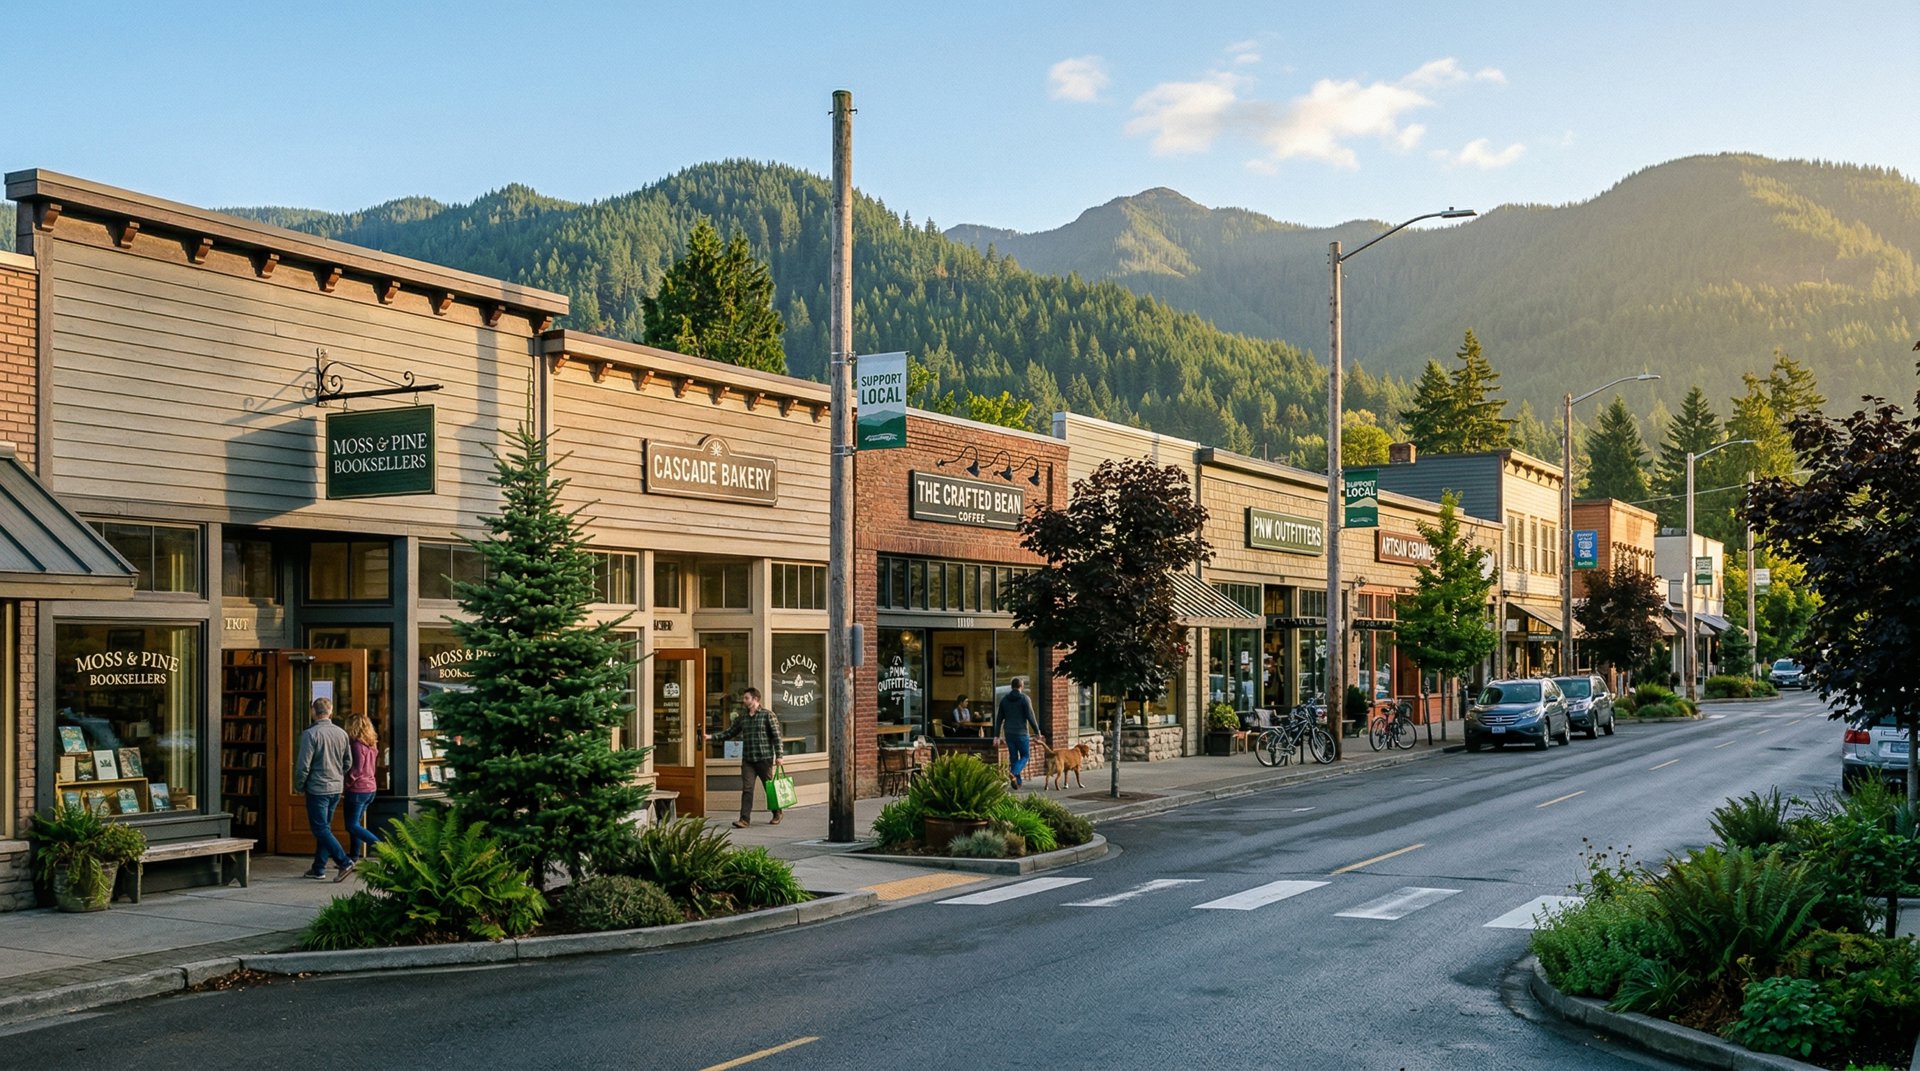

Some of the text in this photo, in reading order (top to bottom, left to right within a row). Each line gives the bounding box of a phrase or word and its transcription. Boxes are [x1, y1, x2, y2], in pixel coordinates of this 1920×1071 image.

[861, 373, 902, 387] SUPPORT
[862, 387, 902, 405] LOCAL
[333, 433, 427, 455] MOSS & PINE
[334, 454, 426, 474] BOOKSELLERS
[654, 454, 771, 491] CASCADE BAKERY
[918, 480, 1021, 514] THE CRAFTED BEAN
[1346, 487, 1376, 497] LOCAL
[958, 511, 985, 523] COFFEE
[1253, 516, 1322, 547] PNW OUTFITTERS
[1381, 536, 1407, 557] ARTISAN
[75, 651, 180, 673] MOSS & PINE
[429, 649, 463, 669] MOSS
[465, 649, 474, 660] &
[780, 654, 818, 675] CASCADE
[90, 673, 167, 686] BOOKSELLERS
[782, 689, 814, 706] BAKERY
